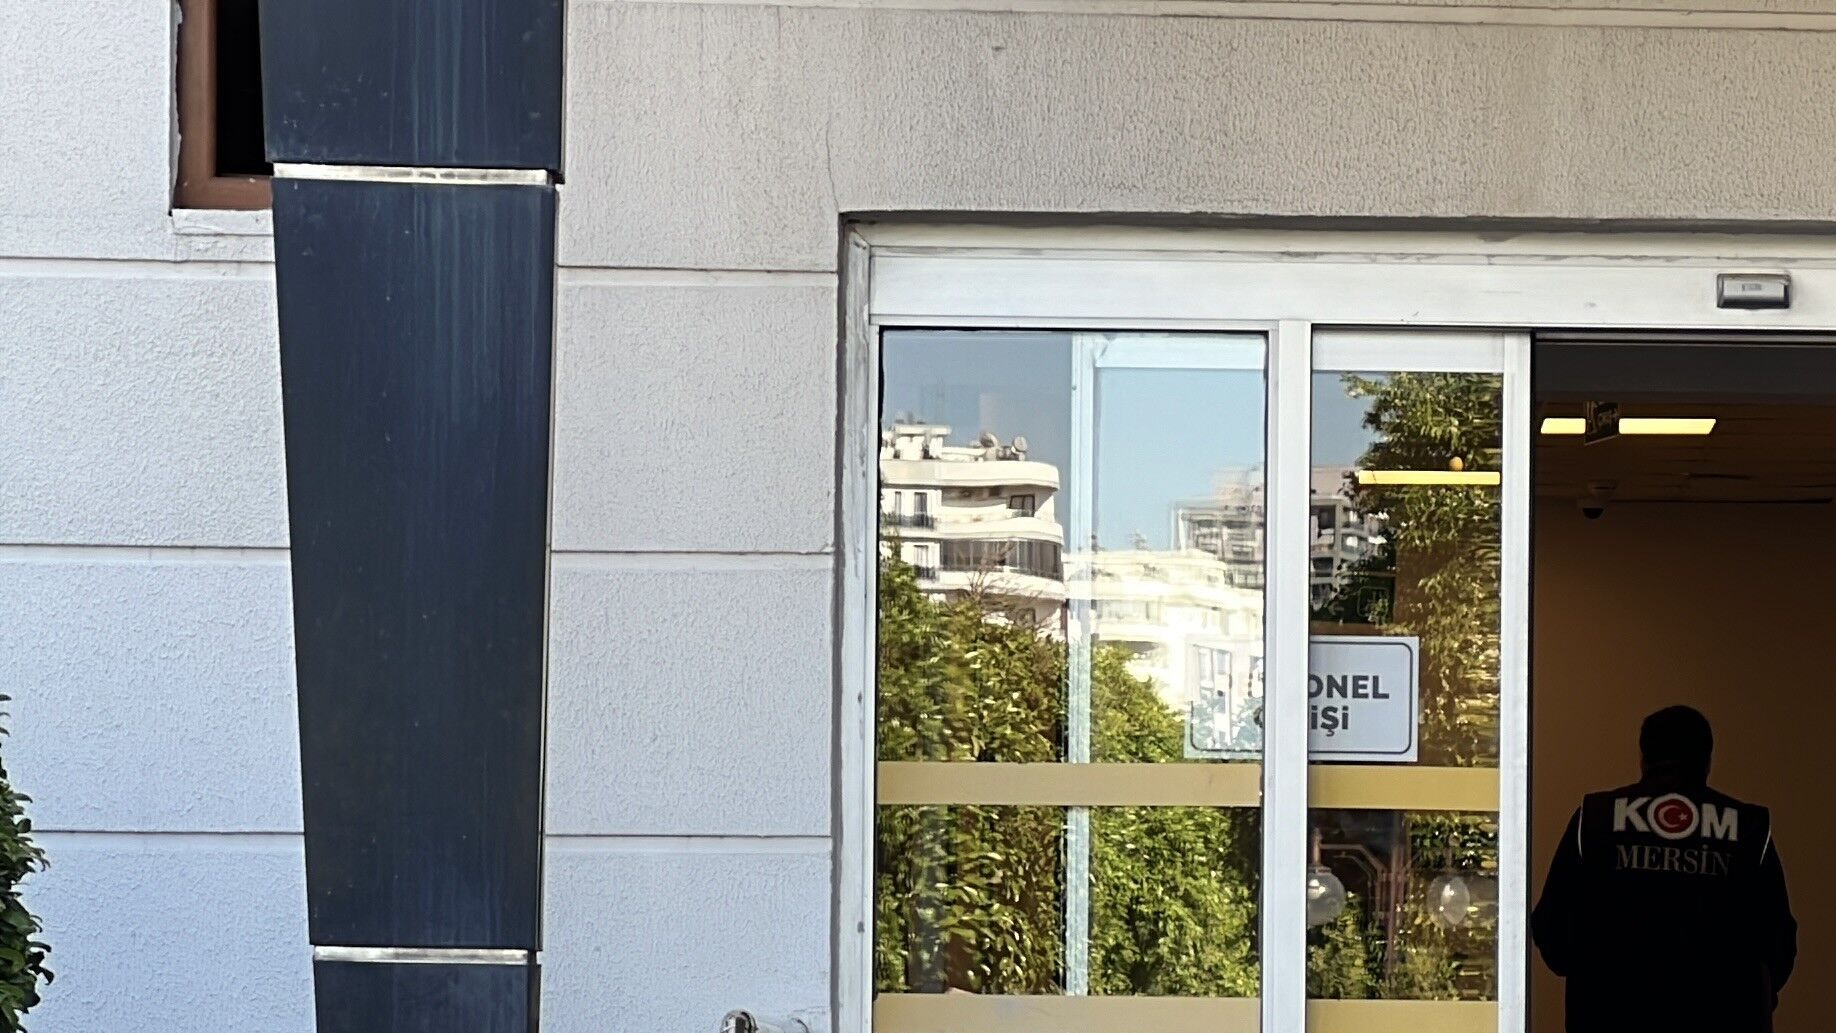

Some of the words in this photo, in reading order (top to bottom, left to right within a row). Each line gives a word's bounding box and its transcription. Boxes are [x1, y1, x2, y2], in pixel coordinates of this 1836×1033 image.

[1308, 673, 1390, 699] ONEL
[1612, 792, 1739, 842] KOM
[1615, 843, 1737, 879] MERSİN
